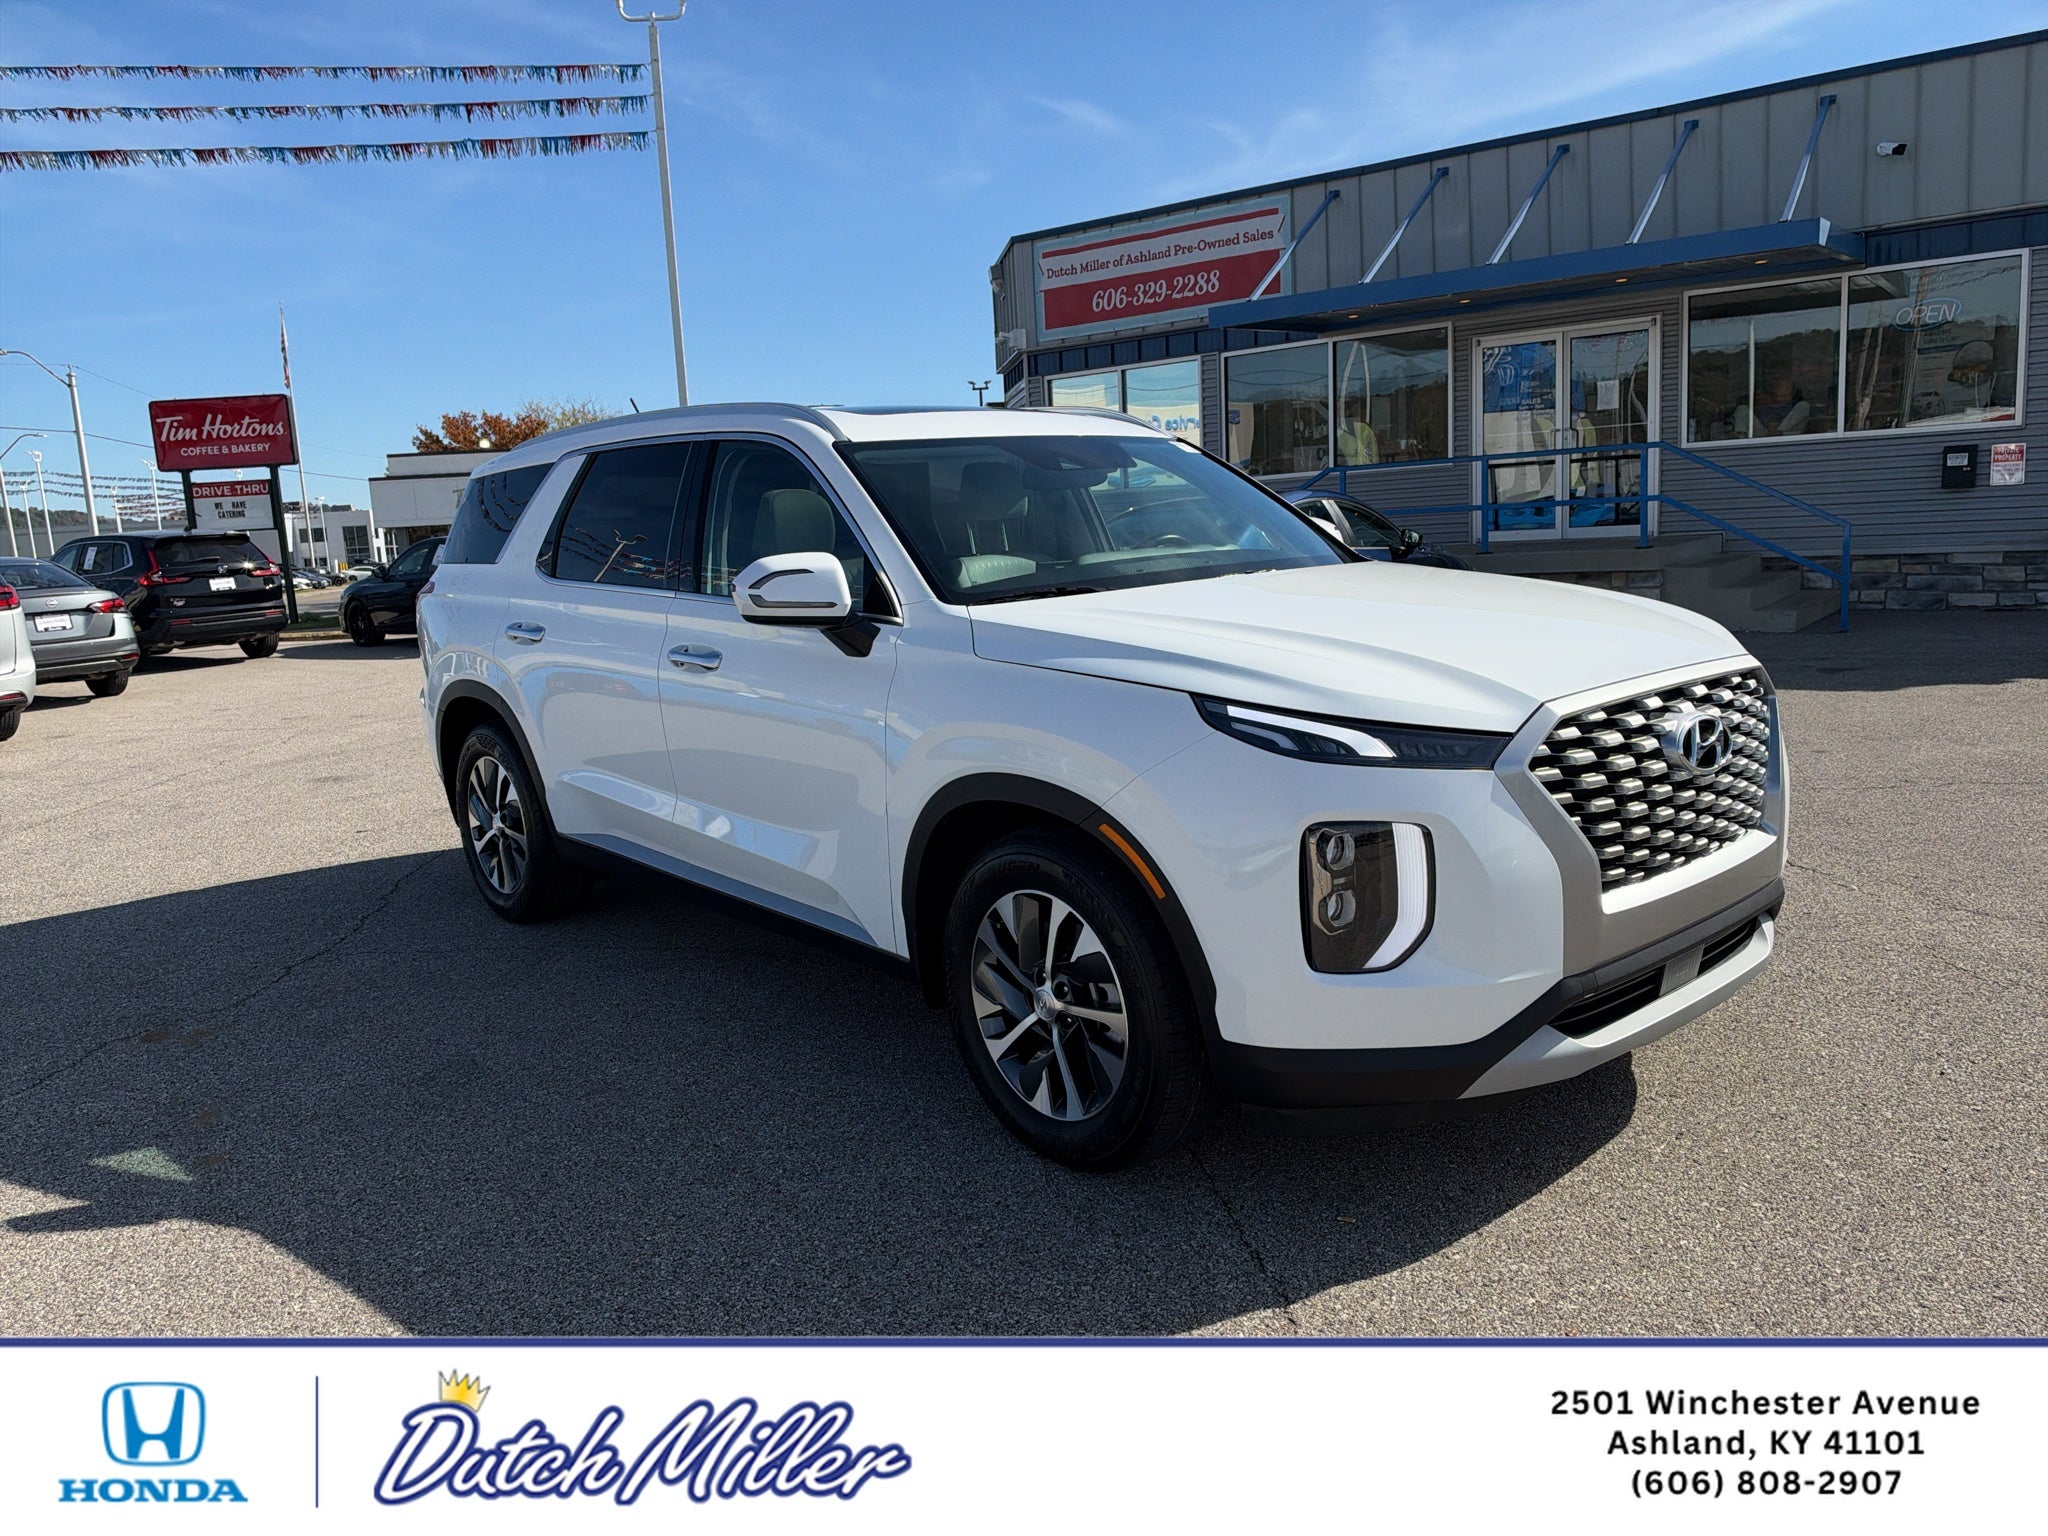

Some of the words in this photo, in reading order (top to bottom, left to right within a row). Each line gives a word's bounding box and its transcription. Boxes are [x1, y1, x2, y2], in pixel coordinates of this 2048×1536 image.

[1046, 264, 1078, 279] Dutch
[1079, 258, 1112, 273] Miller
[1113, 254, 1125, 267] of
[1125, 246, 1171, 266] Ashland
[1174, 233, 1240, 256] Pre-Owned
[1243, 229, 1274, 243] Sales
[1092, 270, 1220, 312] 606-329-2288
[1896, 303, 1956, 325] OPEN
[156, 416, 198, 442] Tim
[201, 413, 284, 440] Hortons
[180, 446, 220, 457] COFFEE
[221, 446, 229, 454] &
[231, 443, 271, 454] BAKERY
[1997, 446, 2020, 455] PRIVATE
[1995, 453, 2022, 462] PROPERTY
[192, 485, 232, 497] DRIVE
[235, 483, 269, 495] THRU
[214, 502, 223, 510] WE
[231, 501, 247, 510] HAVE
[217, 509, 246, 519] CATERING
